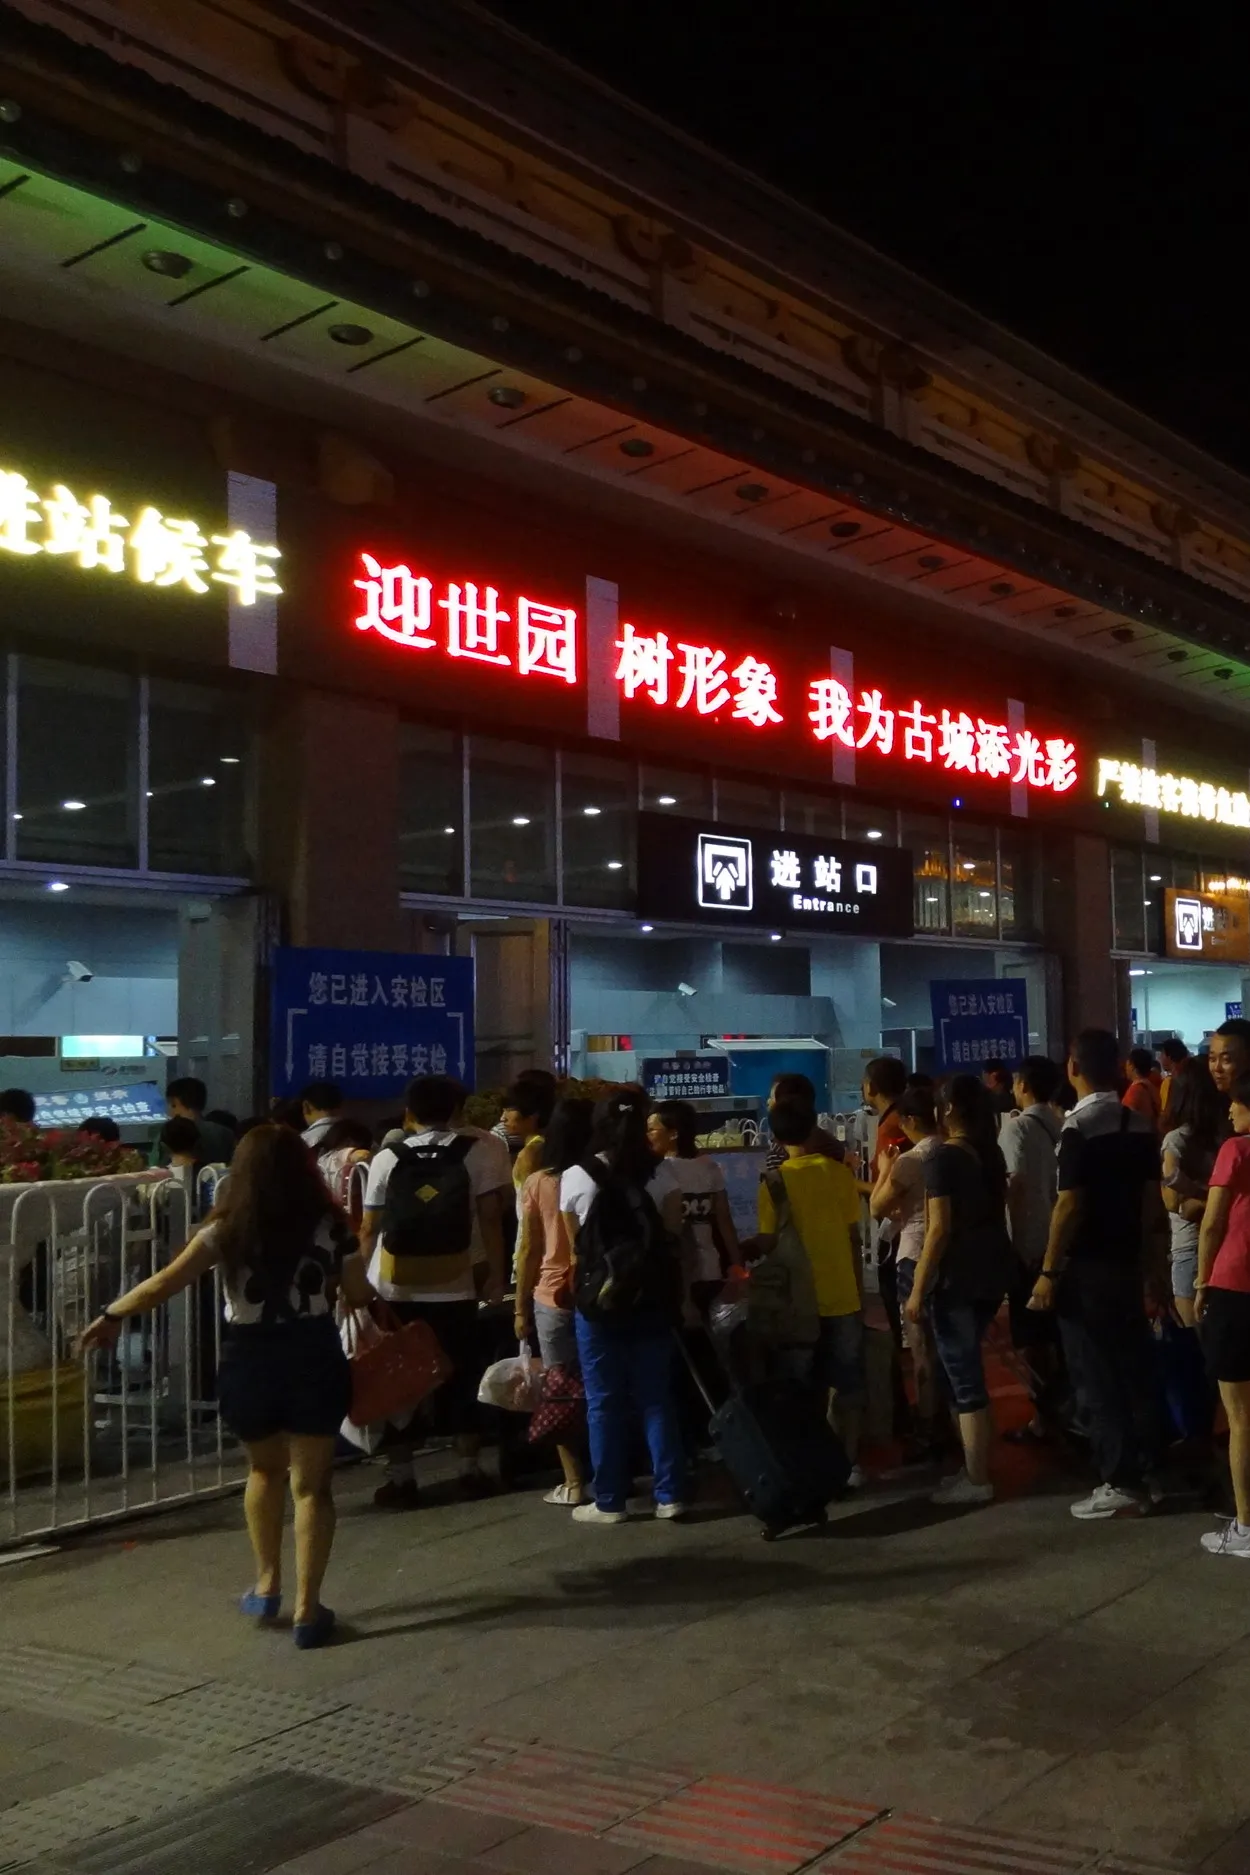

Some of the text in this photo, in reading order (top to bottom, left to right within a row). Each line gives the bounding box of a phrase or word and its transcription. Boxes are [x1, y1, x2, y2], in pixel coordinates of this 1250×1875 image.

[354, 552, 1077, 793] 迎世园 树形象 我为古城添光彩
[771, 849, 878, 895] 进站口
[792, 894, 860, 914] Entrance
[308, 971, 447, 1009] 您已进入安检区
[948, 993, 1015, 1016] 您已进入安检区
[308, 1043, 448, 1078] 请自觉接受安检
[952, 1038, 1017, 1063] 请自觉接受安检
